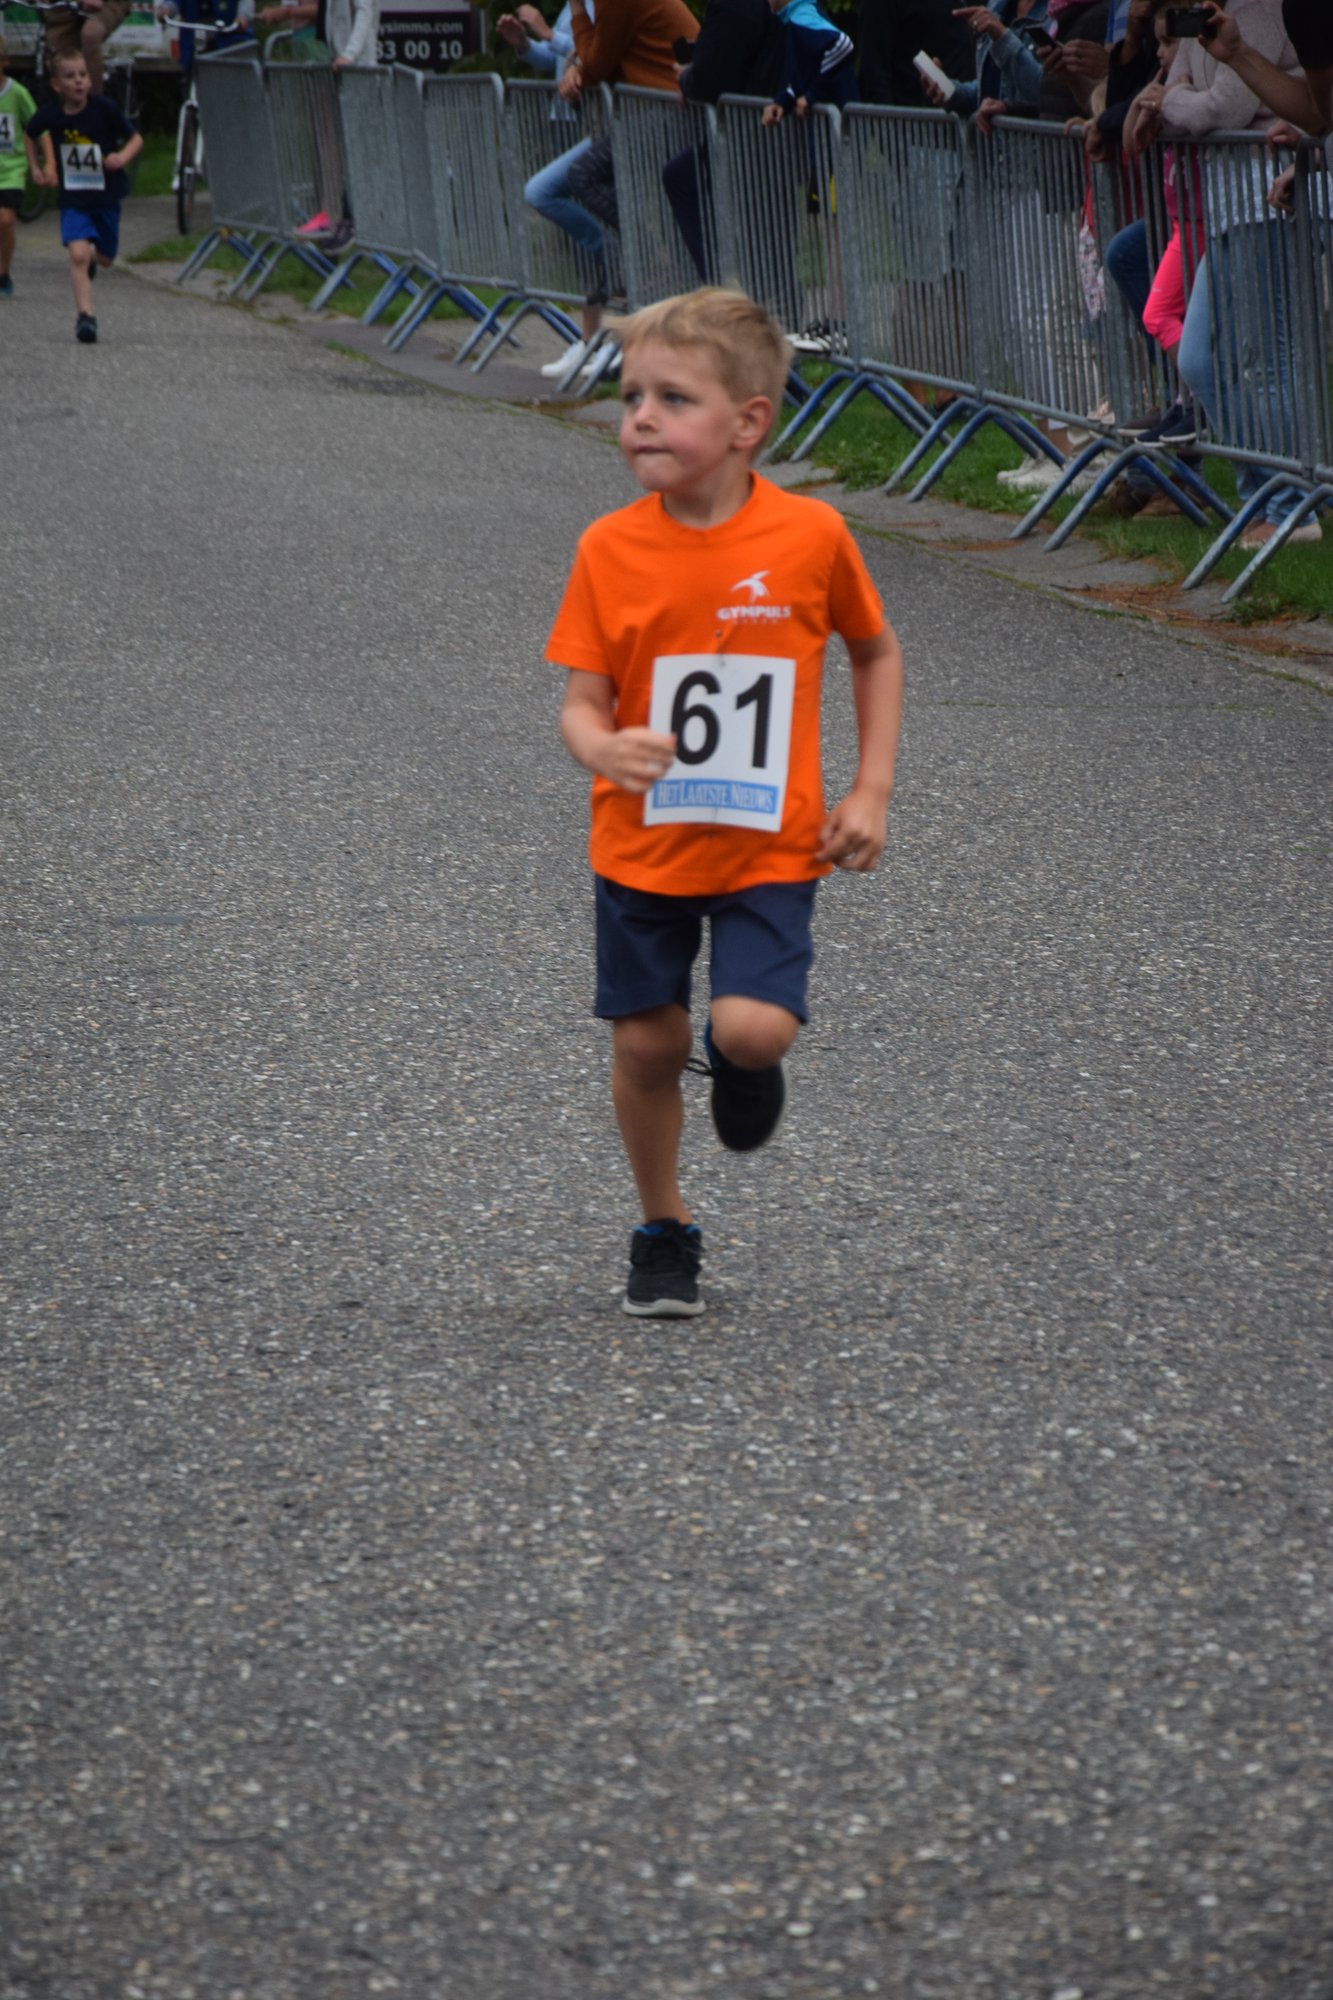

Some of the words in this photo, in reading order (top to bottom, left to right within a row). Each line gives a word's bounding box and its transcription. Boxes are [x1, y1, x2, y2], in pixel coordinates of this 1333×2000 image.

[404, 40, 430, 59] 00
[439, 40, 462, 59] 10
[67, 147, 98, 171] 44
[717, 605, 792, 621] GYMPULS
[671, 670, 773, 769] 61
[657, 782, 681, 806] HET
[680, 781, 729, 806] LAATSTE
